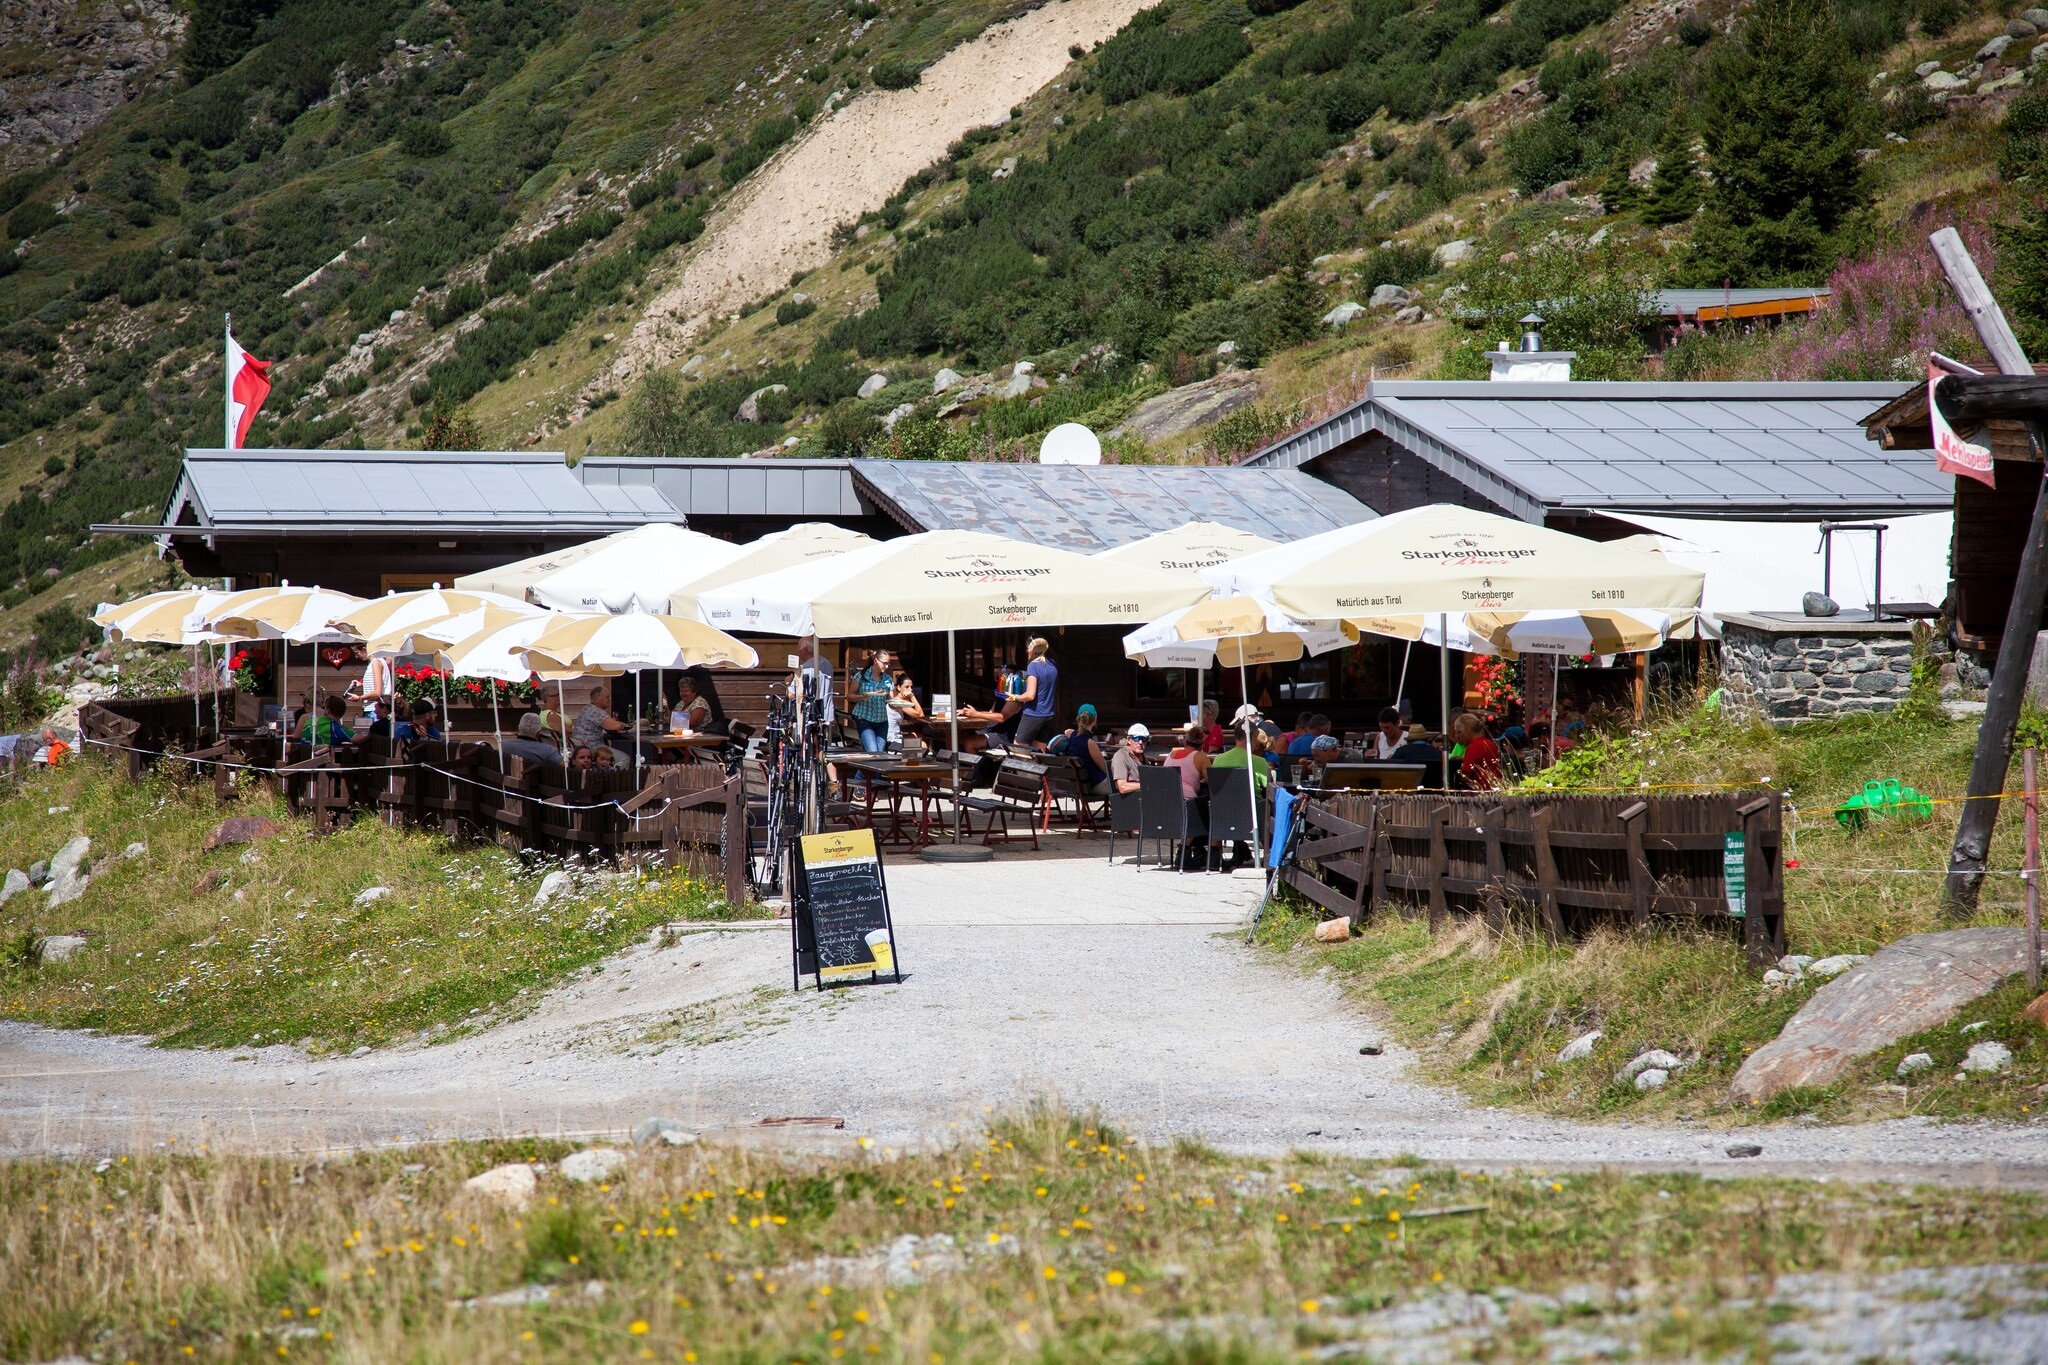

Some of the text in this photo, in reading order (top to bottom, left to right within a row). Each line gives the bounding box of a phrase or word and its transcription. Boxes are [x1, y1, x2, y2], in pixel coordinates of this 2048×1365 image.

[1402, 548, 1538, 560] Starkenberger
[1160, 560, 1228, 569] Starken
[924, 566, 1052, 579] Starkenberger
[1462, 590, 1514, 601] Starkenberger
[1592, 590, 1625, 599] Seit 1810
[1336, 596, 1370, 607] Natürlich
[1385, 595, 1402, 605] Tirol
[1475, 598, 1503, 608] Bier
[988, 604, 1037, 615] Starkenberger
[1108, 604, 1139, 613] Seit 1810
[871, 614, 902, 624] Natürlich
[918, 612, 933, 621] Tirol
[1001, 612, 1026, 623] Bier
[328, 651, 342, 661] WC
[824, 846, 854, 854] Starkenberger
